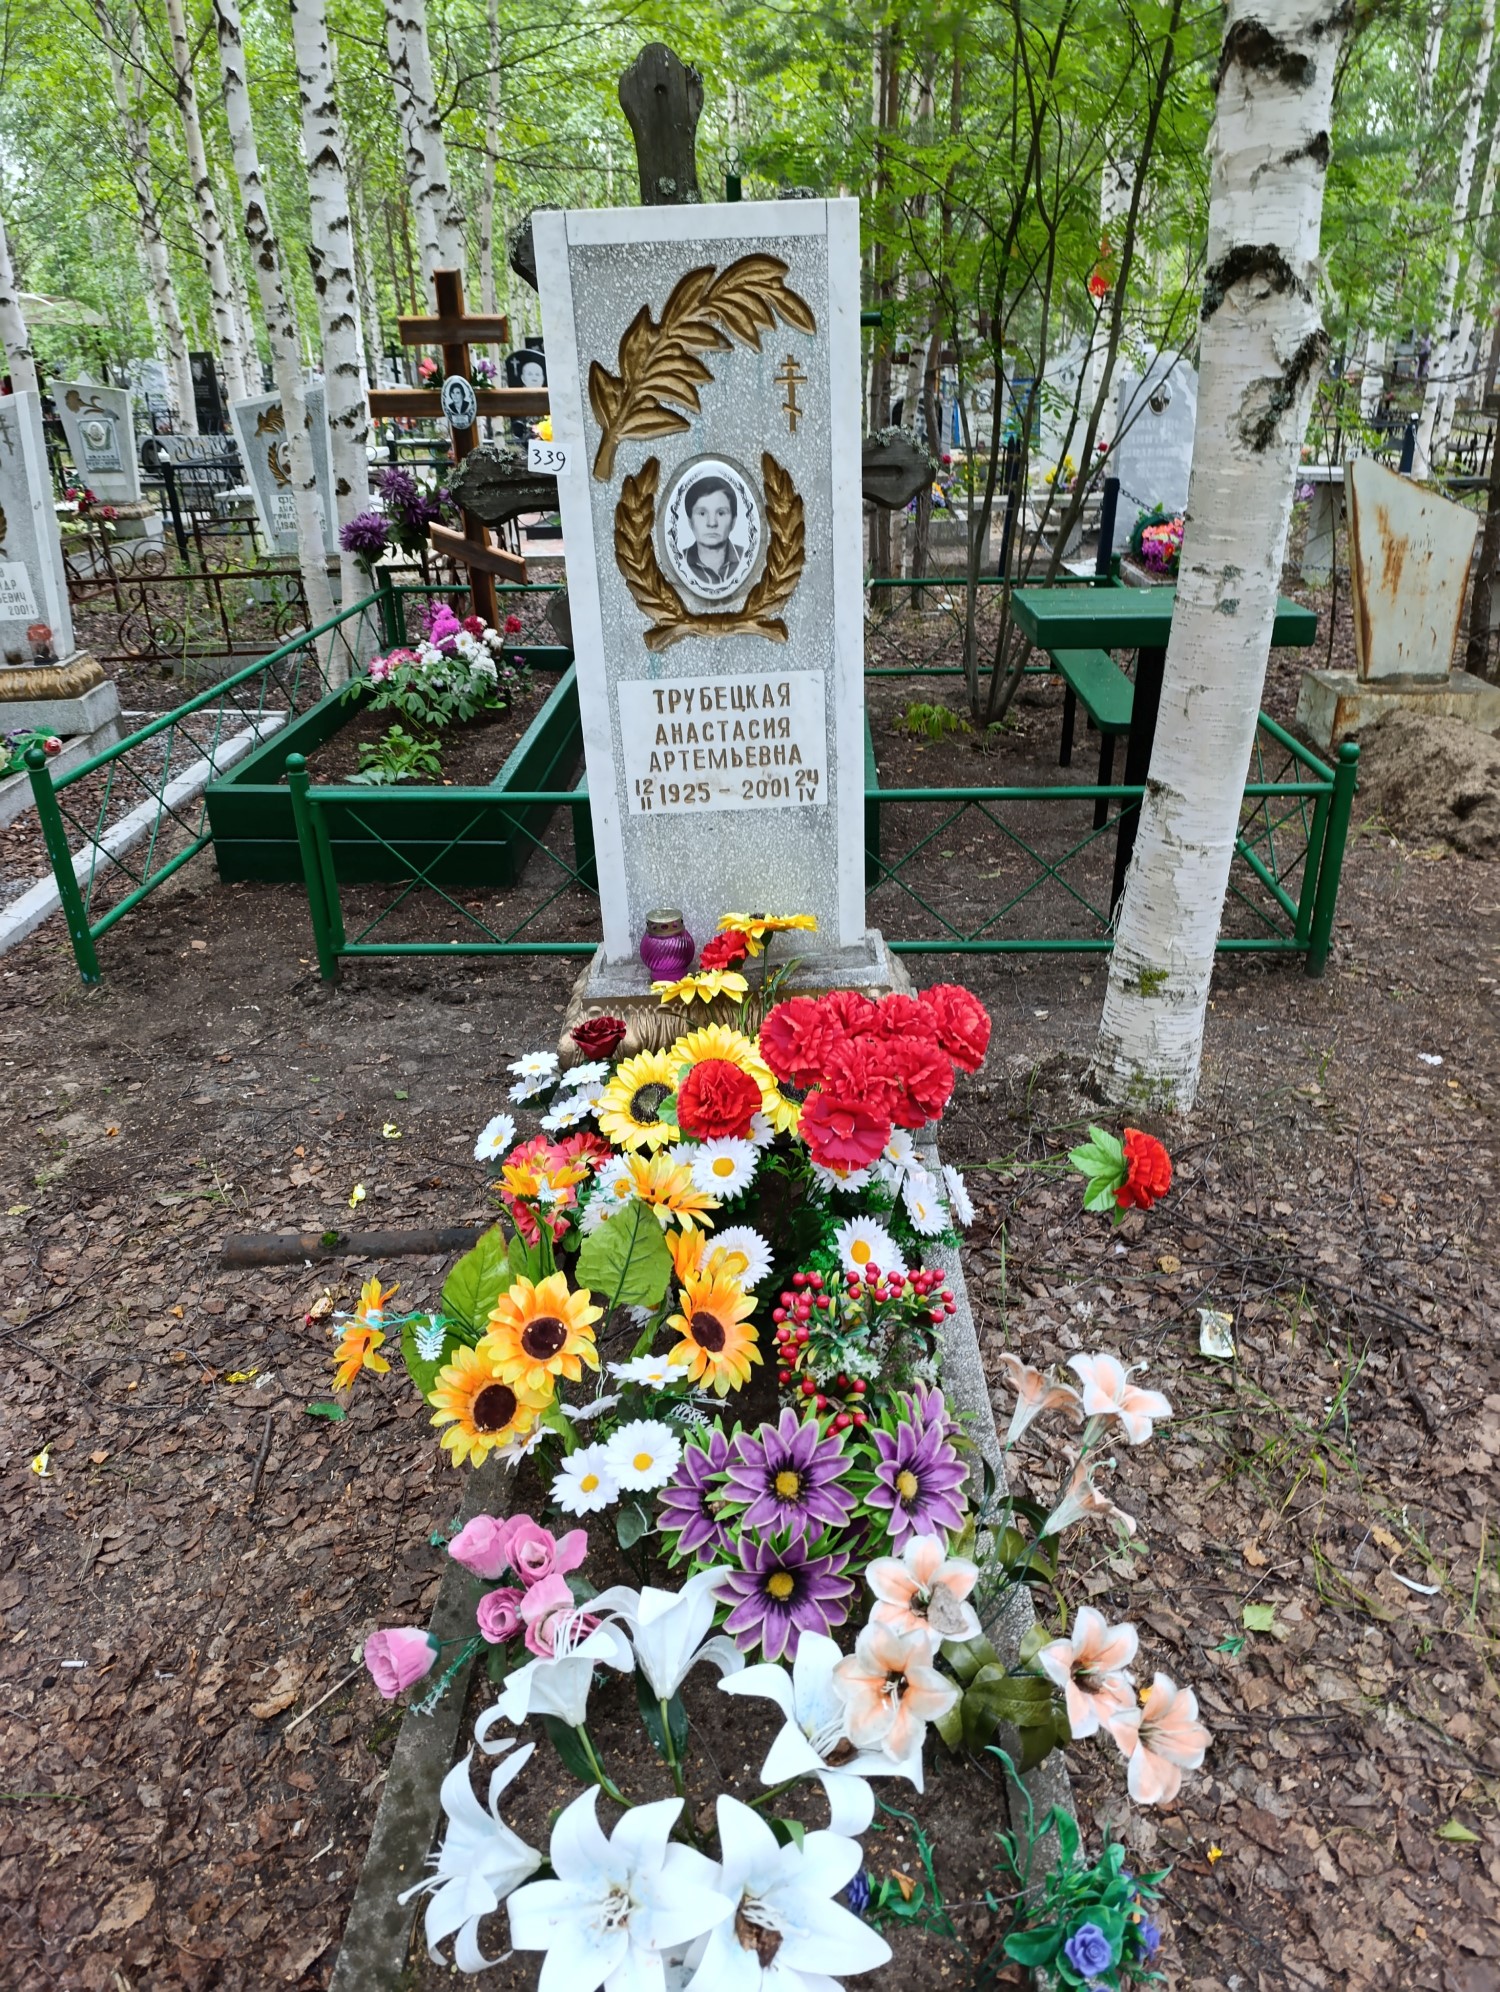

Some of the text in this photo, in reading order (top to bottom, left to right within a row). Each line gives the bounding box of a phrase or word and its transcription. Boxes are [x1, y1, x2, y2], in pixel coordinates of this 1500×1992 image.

[533, 449, 566, 471] 339
[652, 682, 791, 714] ТРУБЕЦКАЯ
[655, 716, 791, 746] АНАСТАСИЯ
[649, 744, 802, 773] АРТЕМЬЕВНА
[635, 778, 654, 796] 12
[659, 782, 711, 806] 1925
[741, 777, 790, 799] 2001
